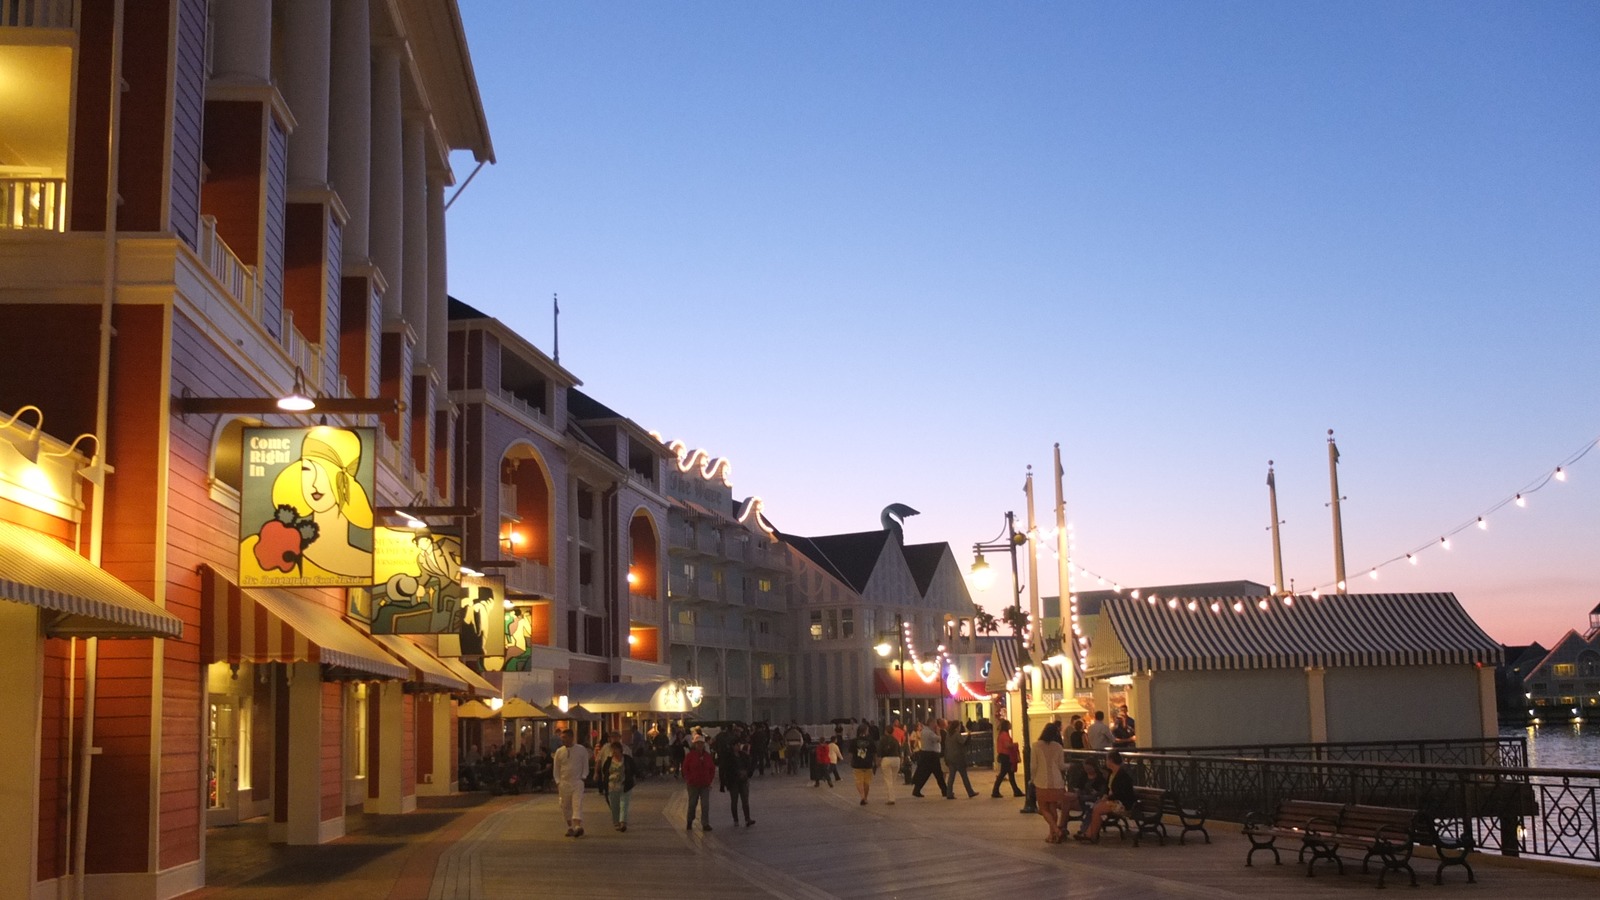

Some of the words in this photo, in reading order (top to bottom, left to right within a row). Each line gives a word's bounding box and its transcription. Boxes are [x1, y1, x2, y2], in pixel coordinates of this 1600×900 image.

[250, 436, 291, 450] Come
[250, 449, 291, 465] Right
[249, 463, 265, 477] In
